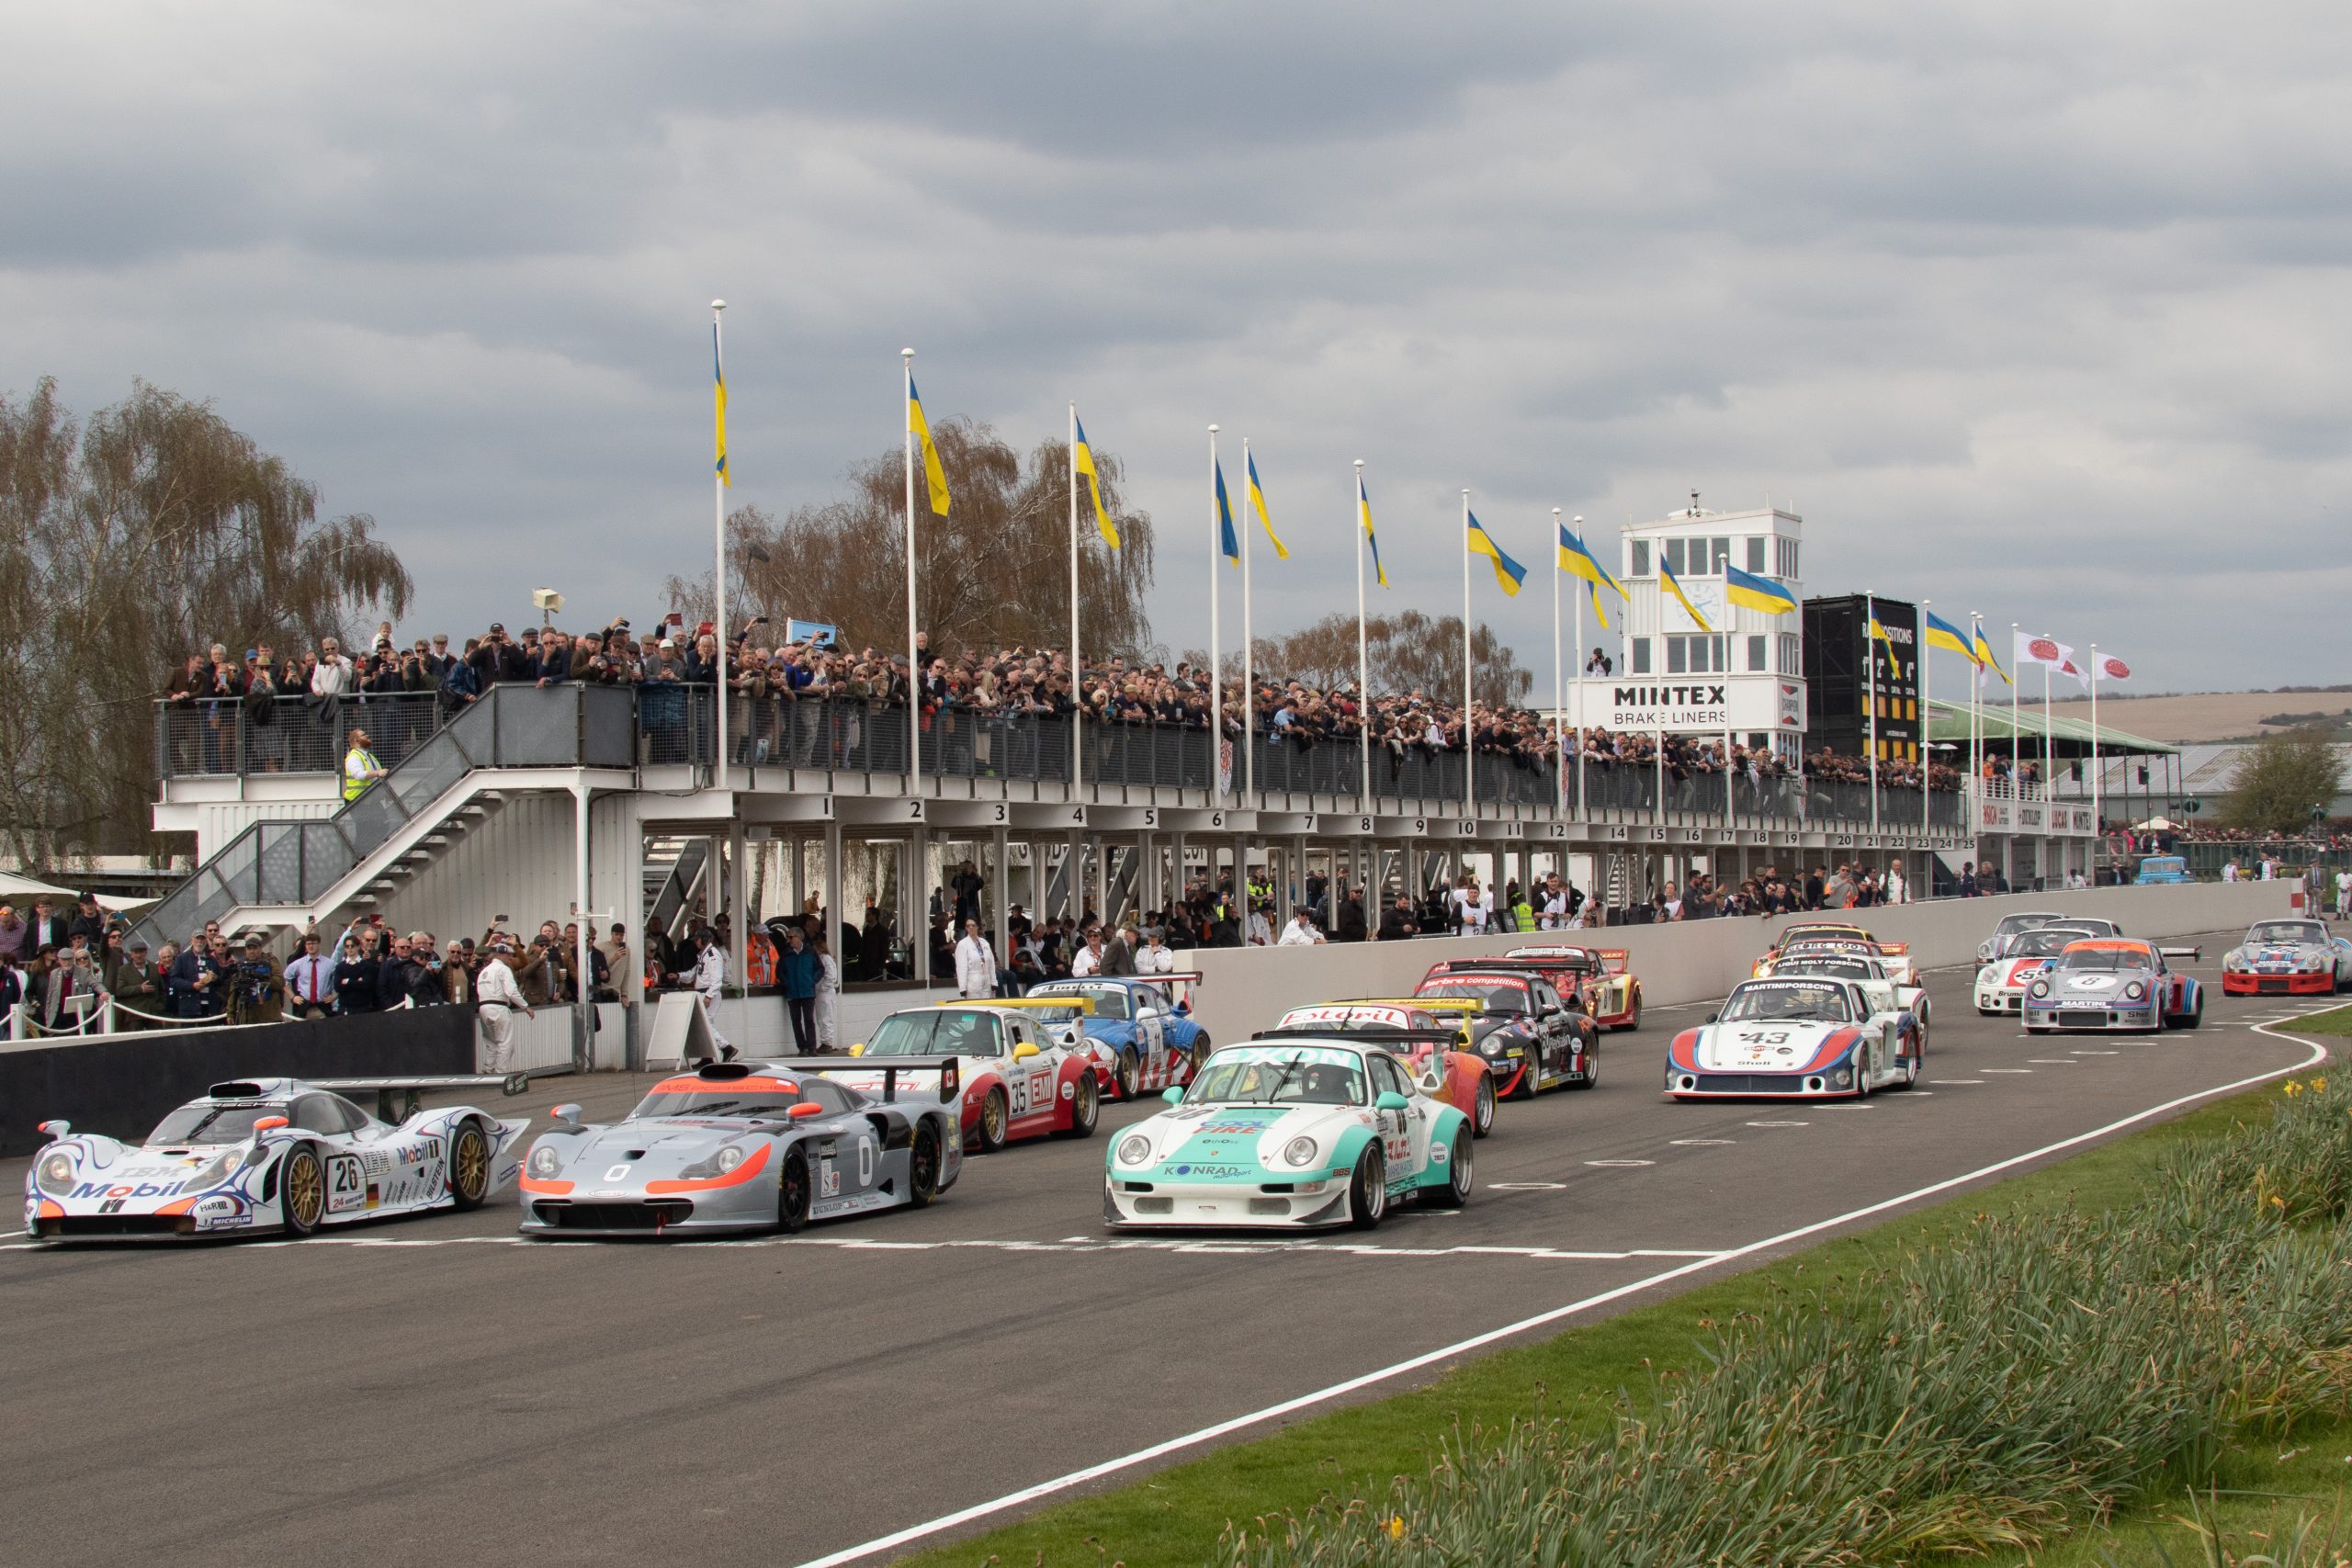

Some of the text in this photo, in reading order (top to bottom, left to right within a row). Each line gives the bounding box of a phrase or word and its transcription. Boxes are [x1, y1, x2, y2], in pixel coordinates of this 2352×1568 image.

[1878, 626, 1913, 645] OSITIONS
[1614, 685, 1724, 706] MINTEX
[1614, 711, 1725, 725] BRAKE LINERS
[823, 797, 830, 815] 1
[910, 801, 922, 818] 2
[995, 805, 1005, 821] 3
[1072, 807, 1084, 823] 4
[1146, 810, 1155, 825] 5
[1212, 811, 1222, 827] 6
[2021, 809, 2041, 826] DUNLOP
[2052, 810, 2067, 829] LUCAS
[1305, 816, 1314, 829] 7
[1361, 817, 1371, 830] 8
[1416, 818, 1425, 832] 9
[1458, 821, 1474, 835] 10
[1508, 823, 1521, 836] 11
[1550, 825, 1565, 837] 12
[1610, 828, 1625, 839] 14
[1650, 829, 1664, 840] 15
[1685, 829, 1700, 840] 16
[1720, 830, 1734, 841] 17
[1753, 832, 1767, 843] 18
[1785, 833, 1798, 844] 19
[1838, 835, 1851, 845] 20
[1866, 837, 1879, 847] 21
[1890, 837, 1905, 847] 22
[1917, 838, 1929, 848] 23
[1939, 839, 1951, 849] 24
[1962, 840, 1975, 850] 25
[1778, 960, 1799, 968] LIQUI
[1825, 960, 1864, 968] PORSCHE
[1424, 976, 1525, 987] larbre compétition
[1744, 983, 1835, 992] MARTINI PORSCHE
[2081, 976, 2102, 986] 8
[1282, 1010, 1407, 1026] Estoril
[1741, 1032, 1791, 1044] 43
[1214, 1046, 1351, 1066] EXXON
[1032, 1075, 1052, 1102] EMI
[1012, 1082, 1026, 1114] 35
[1192, 1126, 1260, 1135] FIRE
[1199, 1120, 1265, 1128] COOL
[397, 1141, 429, 1166] Mobil
[335, 1158, 358, 1193] 26
[603, 1164, 633, 1182] 0
[1164, 1165, 1239, 1177] KONRAD
[1332, 1168, 1351, 1177] BBS
[425, 1156, 446, 1201] BILSTEIN
[69, 1180, 188, 1199] Mobil
[333, 1197, 345, 1209] 24
[813, 1201, 842, 1215] DUNLOP
[212, 1215, 253, 1225] MICHELIN
